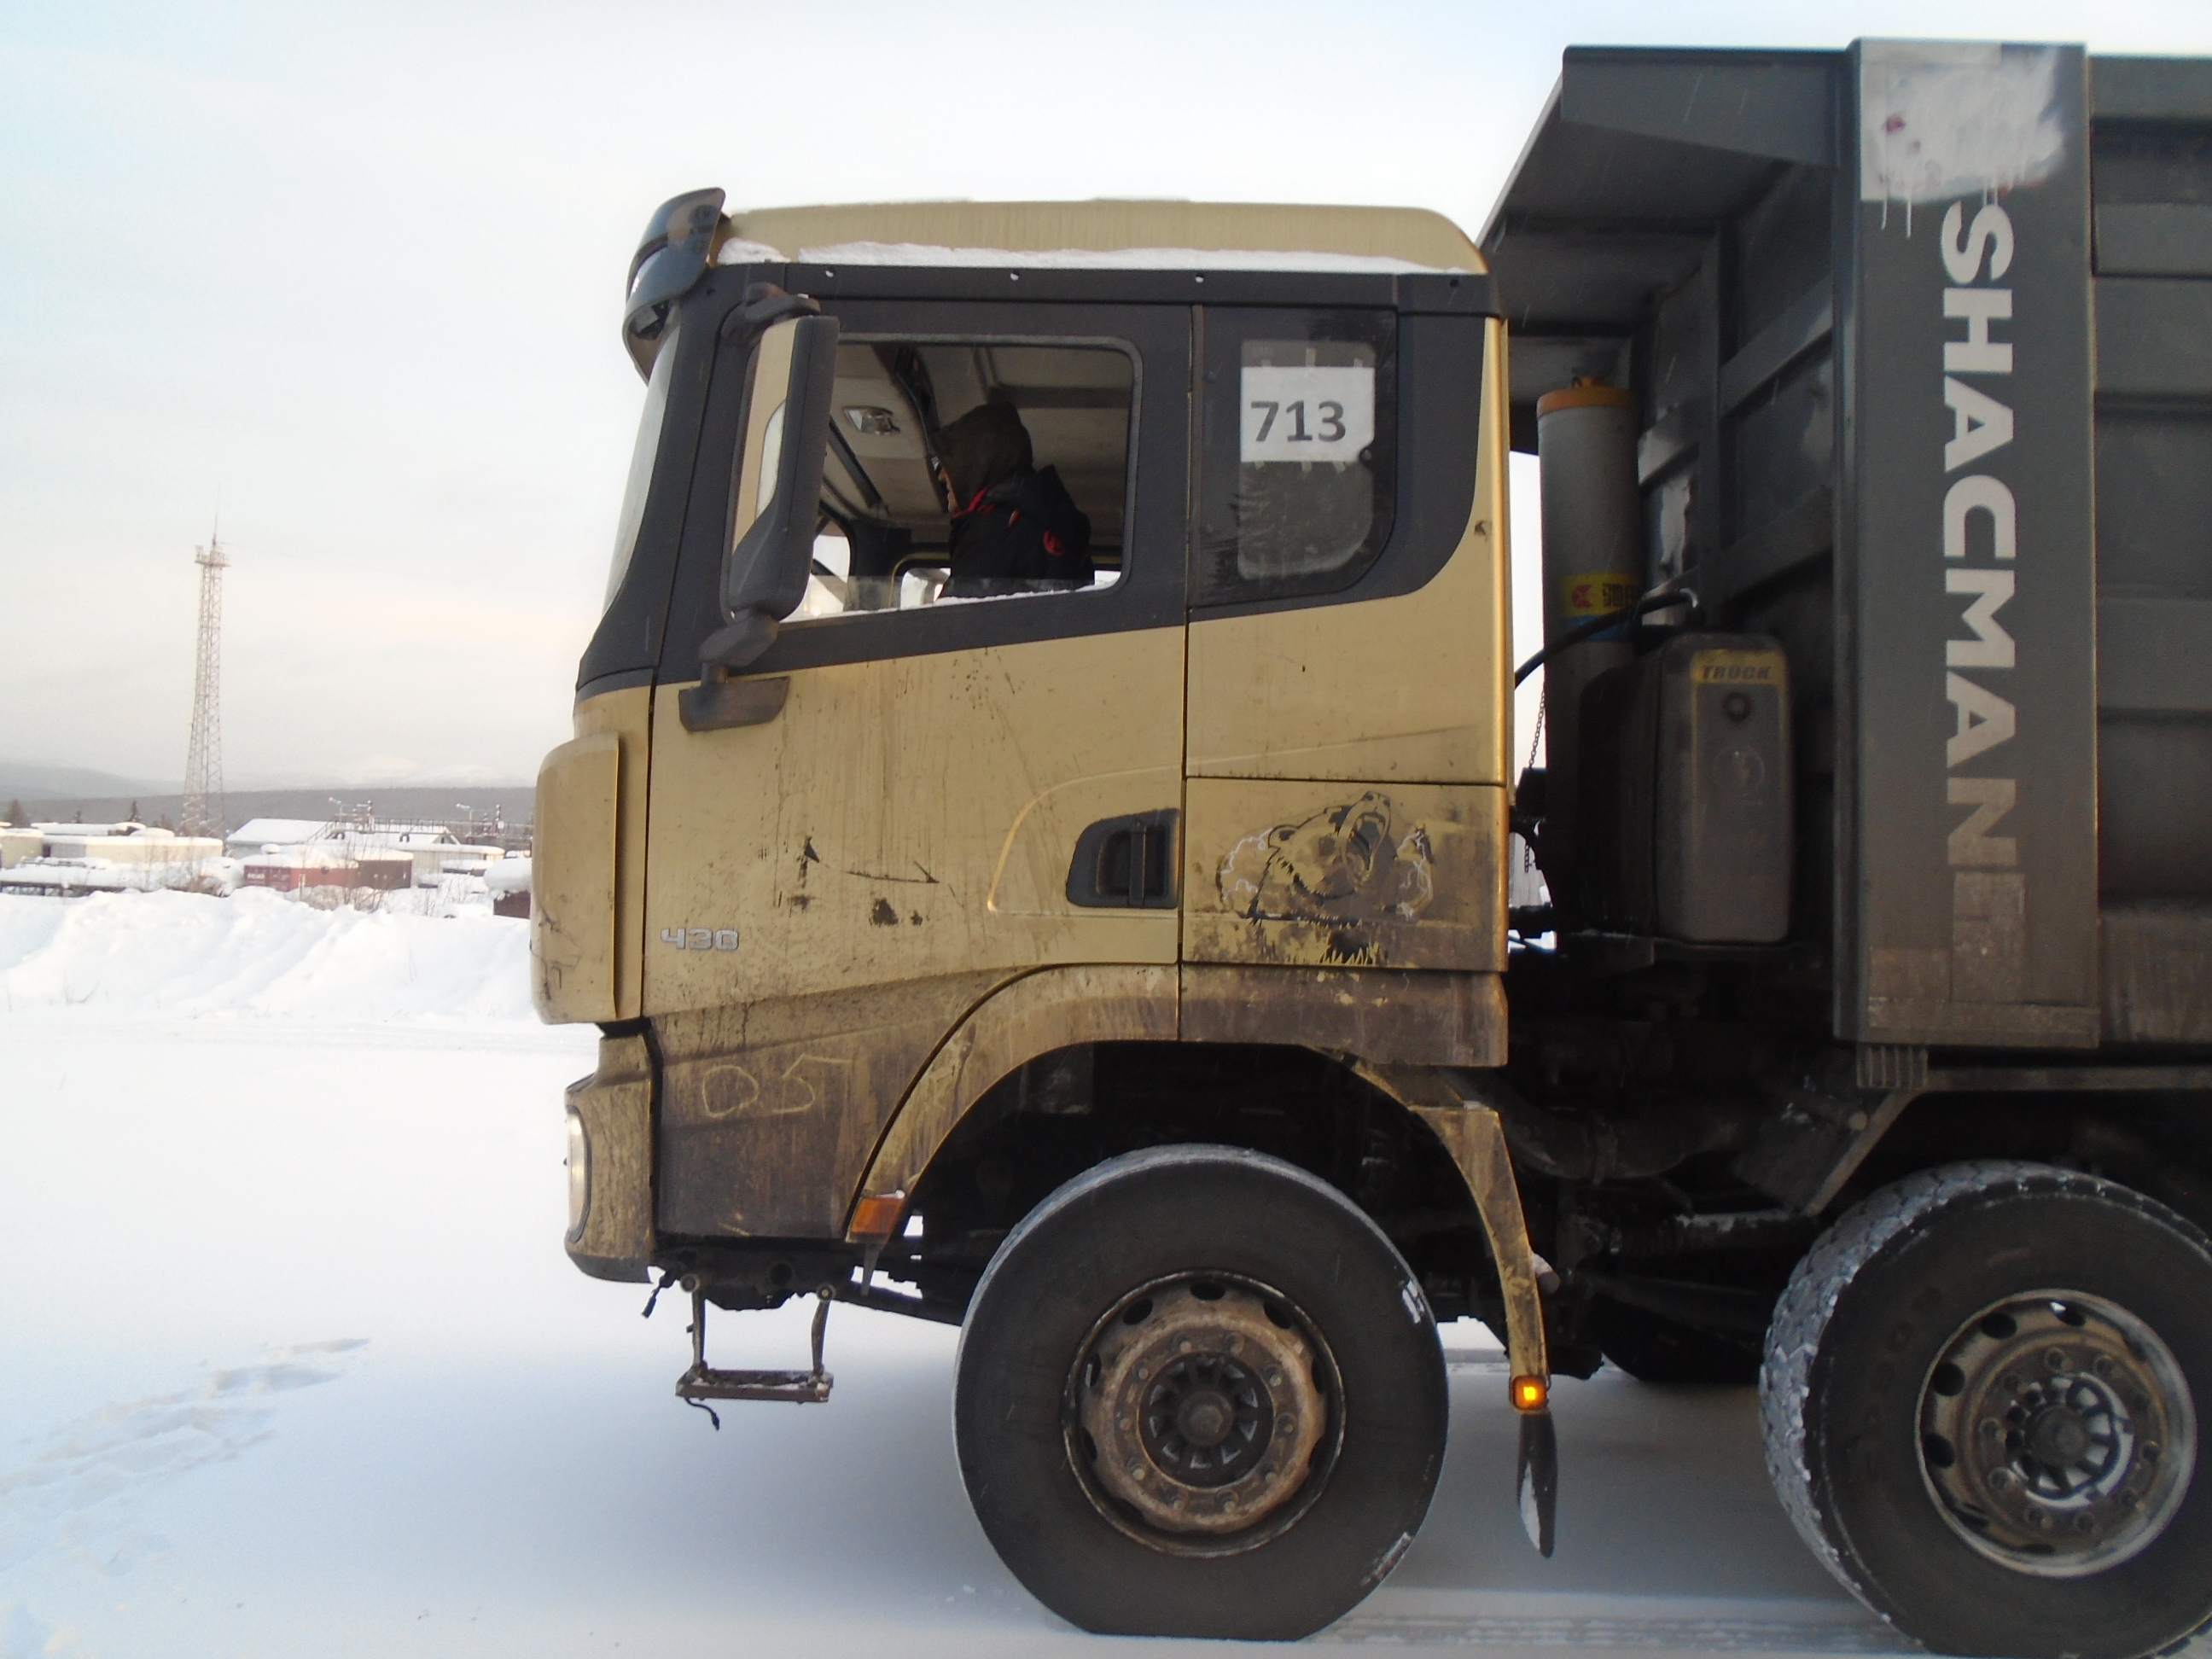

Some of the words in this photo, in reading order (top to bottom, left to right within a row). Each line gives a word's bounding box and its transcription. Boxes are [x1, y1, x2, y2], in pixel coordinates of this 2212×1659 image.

[1250, 400, 1347, 442] 713
[1941, 200, 2016, 867] SHACMAN
[1703, 664, 1772, 680] TRUCK
[661, 927, 740, 951] 430
